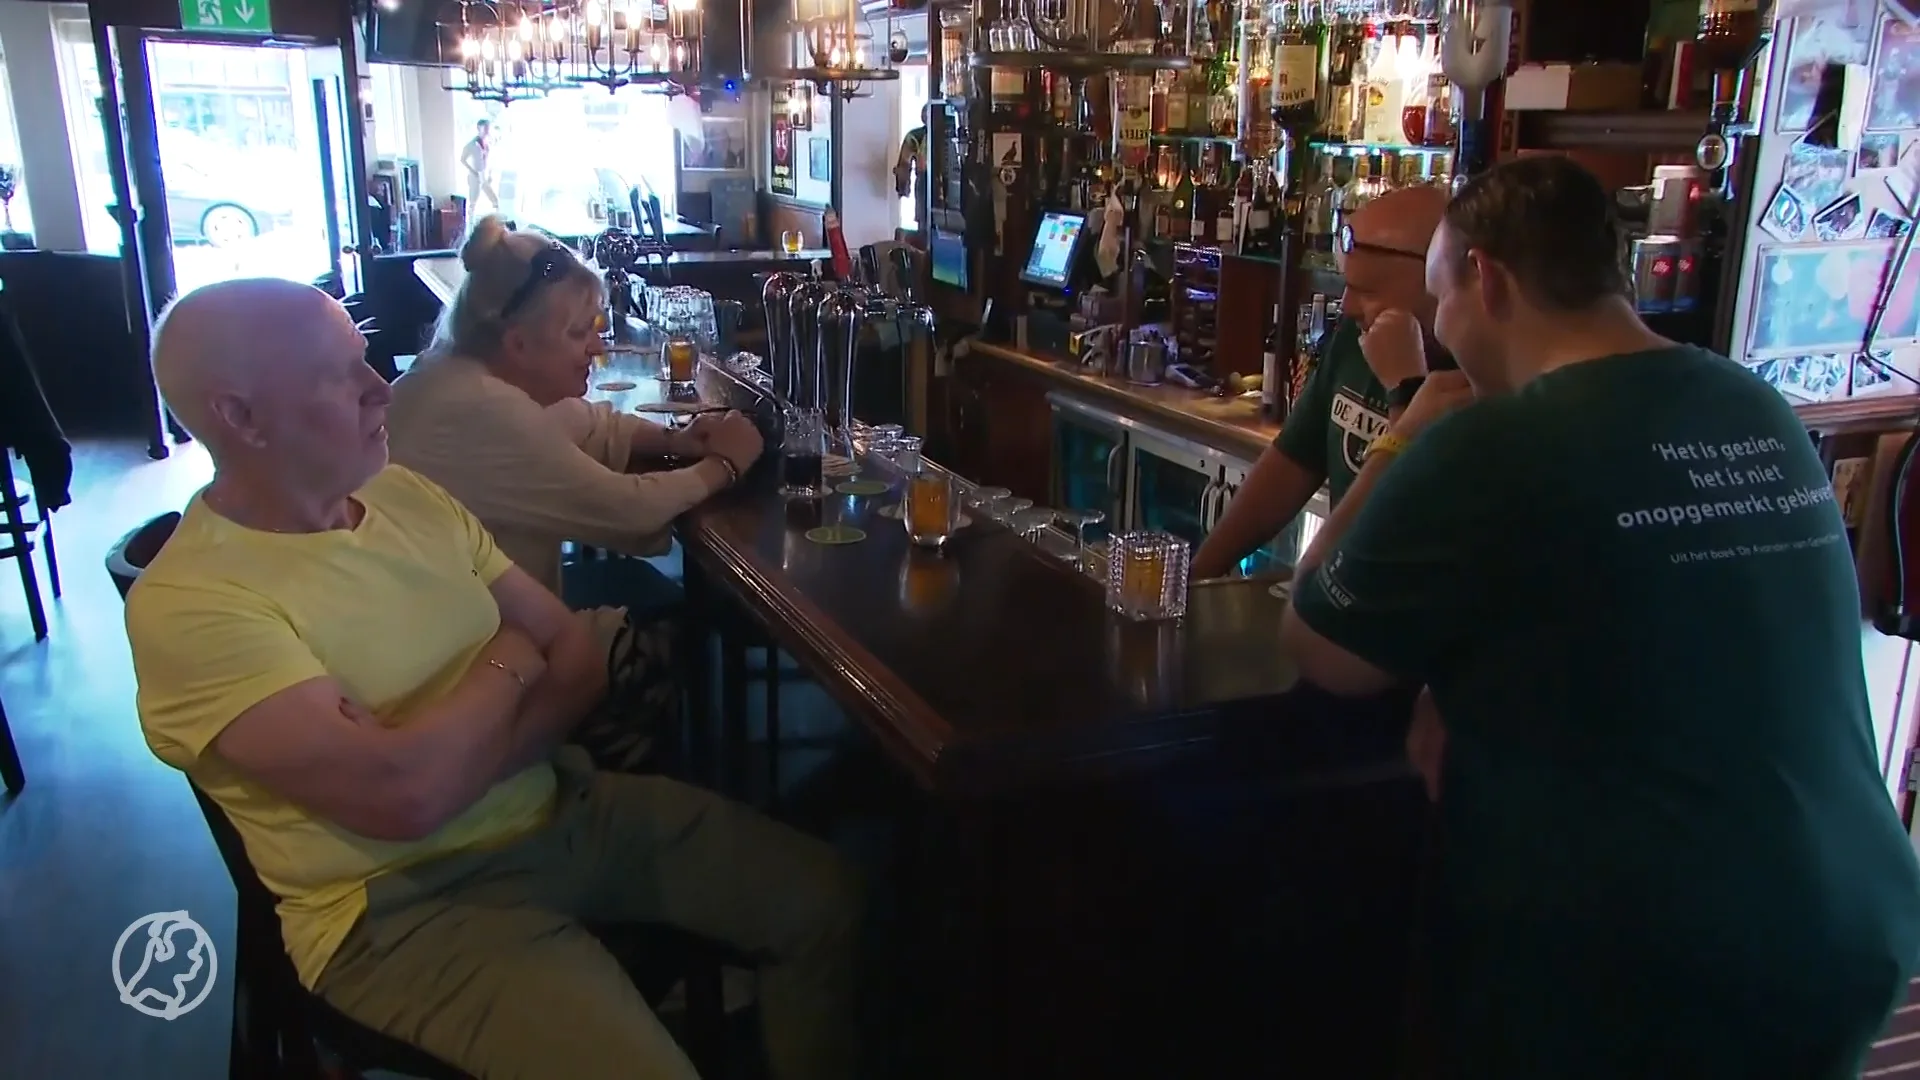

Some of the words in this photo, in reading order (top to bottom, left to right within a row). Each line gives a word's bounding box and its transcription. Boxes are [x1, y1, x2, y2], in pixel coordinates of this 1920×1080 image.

[1333, 399, 1352, 422] DE
[1698, 440, 1718, 459] is
[1721, 436, 1786, 462] gezien,
[1688, 468, 1726, 489] het
[1725, 467, 1744, 486] is
[1747, 463, 1785, 484] niet
[1617, 494, 1775, 528] onopgemerkt
[1670, 552, 1690, 564] Uit
